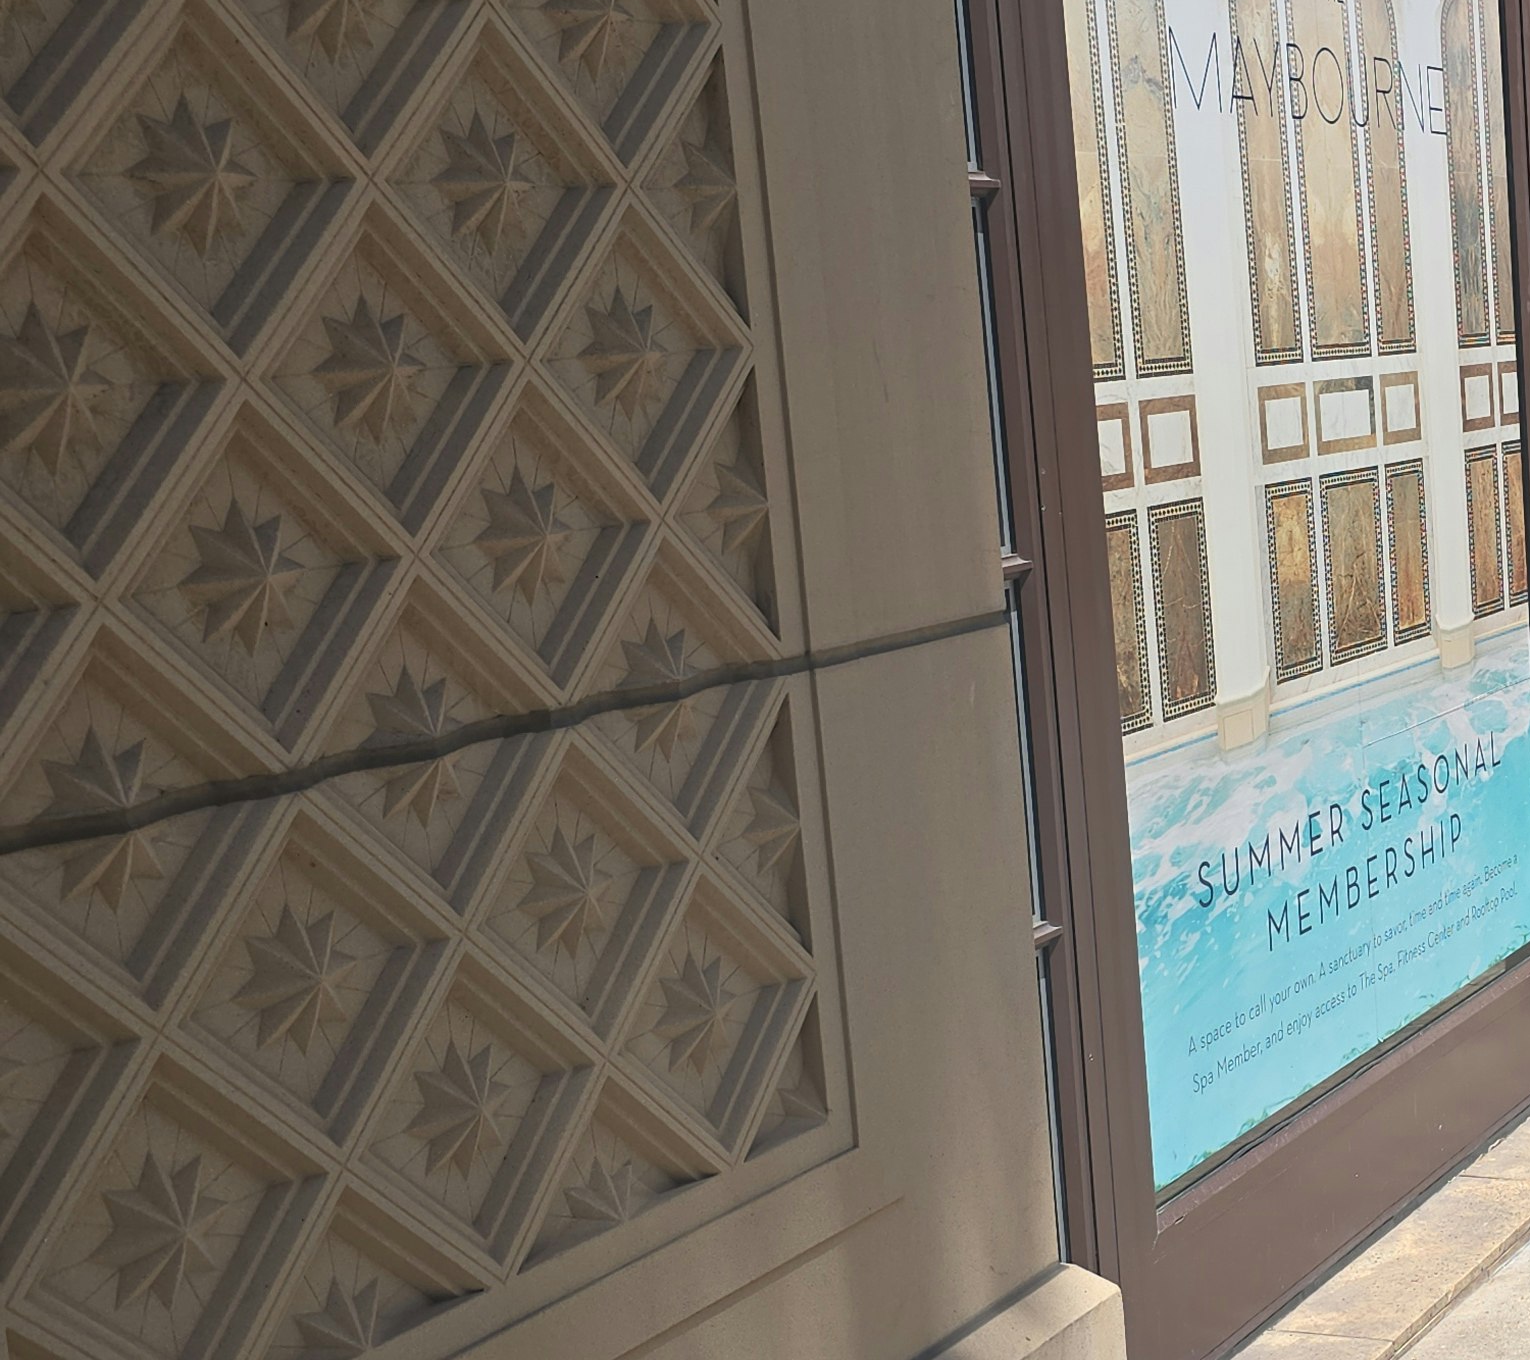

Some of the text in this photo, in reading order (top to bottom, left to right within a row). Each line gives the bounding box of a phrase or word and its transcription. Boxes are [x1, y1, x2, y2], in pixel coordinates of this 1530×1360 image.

[1168, 25, 1448, 136] MAYBOURNE
[1197, 730, 1502, 909] SUMMER SEASONAL
[1266, 812, 1462, 952] MEMBERSHIP
[1188, 1035, 1198, 1057] A
[1200, 1021, 1232, 1051] space
[1234, 1011, 1247, 1029] to
[1248, 994, 1266, 1021] call
[1269, 985, 1292, 1014] your
[1293, 973, 1317, 994] own.
[1318, 961, 1327, 980] A
[1328, 940, 1372, 975] sanctuary
[1373, 933, 1382, 949] to
[1384, 920, 1408, 942] savor,
[1409, 907, 1427, 927] time
[1428, 892, 1443, 915] and
[1444, 886, 1461, 906] time
[1484, 856, 1513, 882] Become
[1513, 853, 1519, 865] a
[1192, 1070, 1214, 1095] Spa
[1216, 1042, 1264, 1078] Member,
[1265, 1020, 1284, 1049] and
[1286, 1011, 1313, 1034] enjoy
[1315, 990, 1346, 1019] access
[1347, 983, 1358, 999] to
[1359, 970, 1376, 990] The
[1397, 940, 1426, 967] Fitness
[1427, 922, 1455, 949] Center
[1456, 909, 1470, 932] and
[1471, 895, 1500, 920] Rooftop
